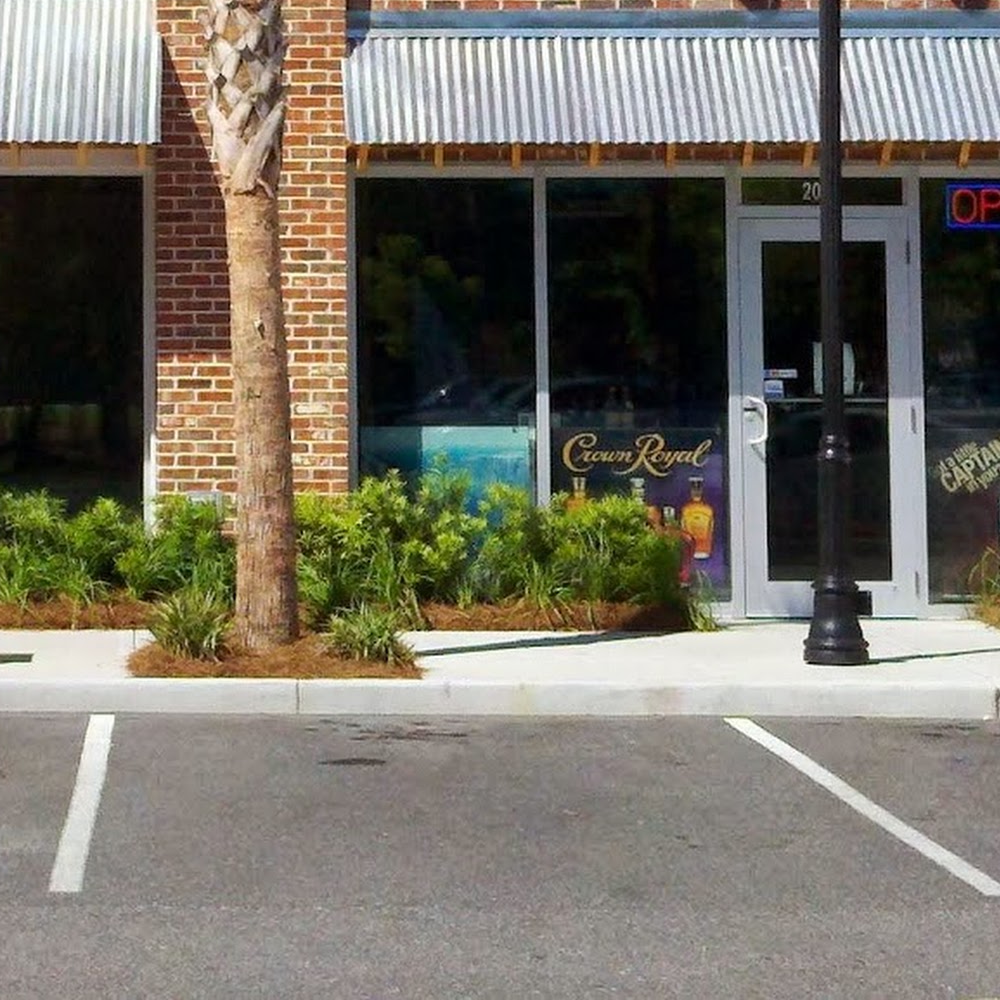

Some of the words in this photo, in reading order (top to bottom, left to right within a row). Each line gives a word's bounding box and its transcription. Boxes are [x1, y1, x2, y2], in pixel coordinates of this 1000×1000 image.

[802, 181, 822, 200] 20
[562, 432, 634, 473] Crown
[612, 433, 713, 477] Royal
